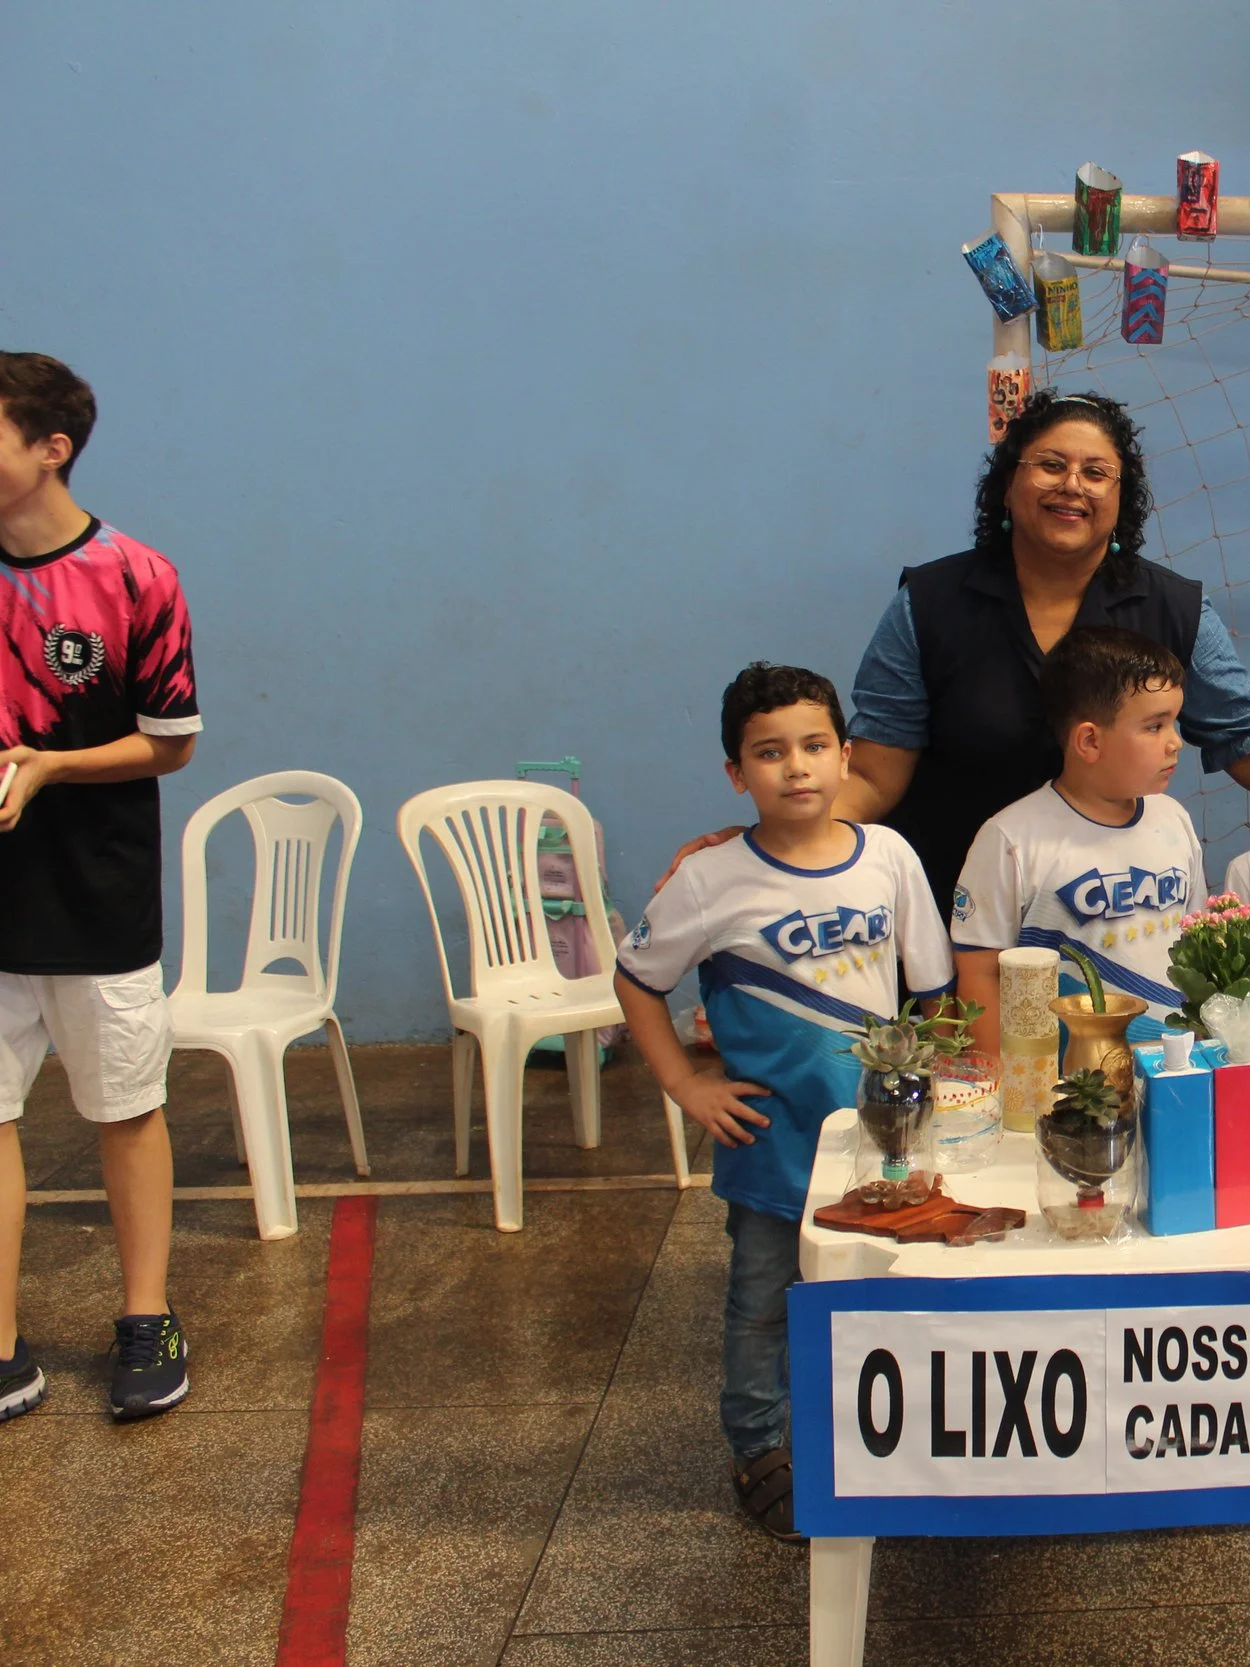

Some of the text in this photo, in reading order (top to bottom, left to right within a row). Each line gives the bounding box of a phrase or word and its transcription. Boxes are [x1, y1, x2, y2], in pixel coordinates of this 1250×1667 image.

[1047, 282, 1078, 296] NINHO
[857, 1348, 1088, 1459] O LIXO
[1125, 1402, 1250, 1460] CADA
